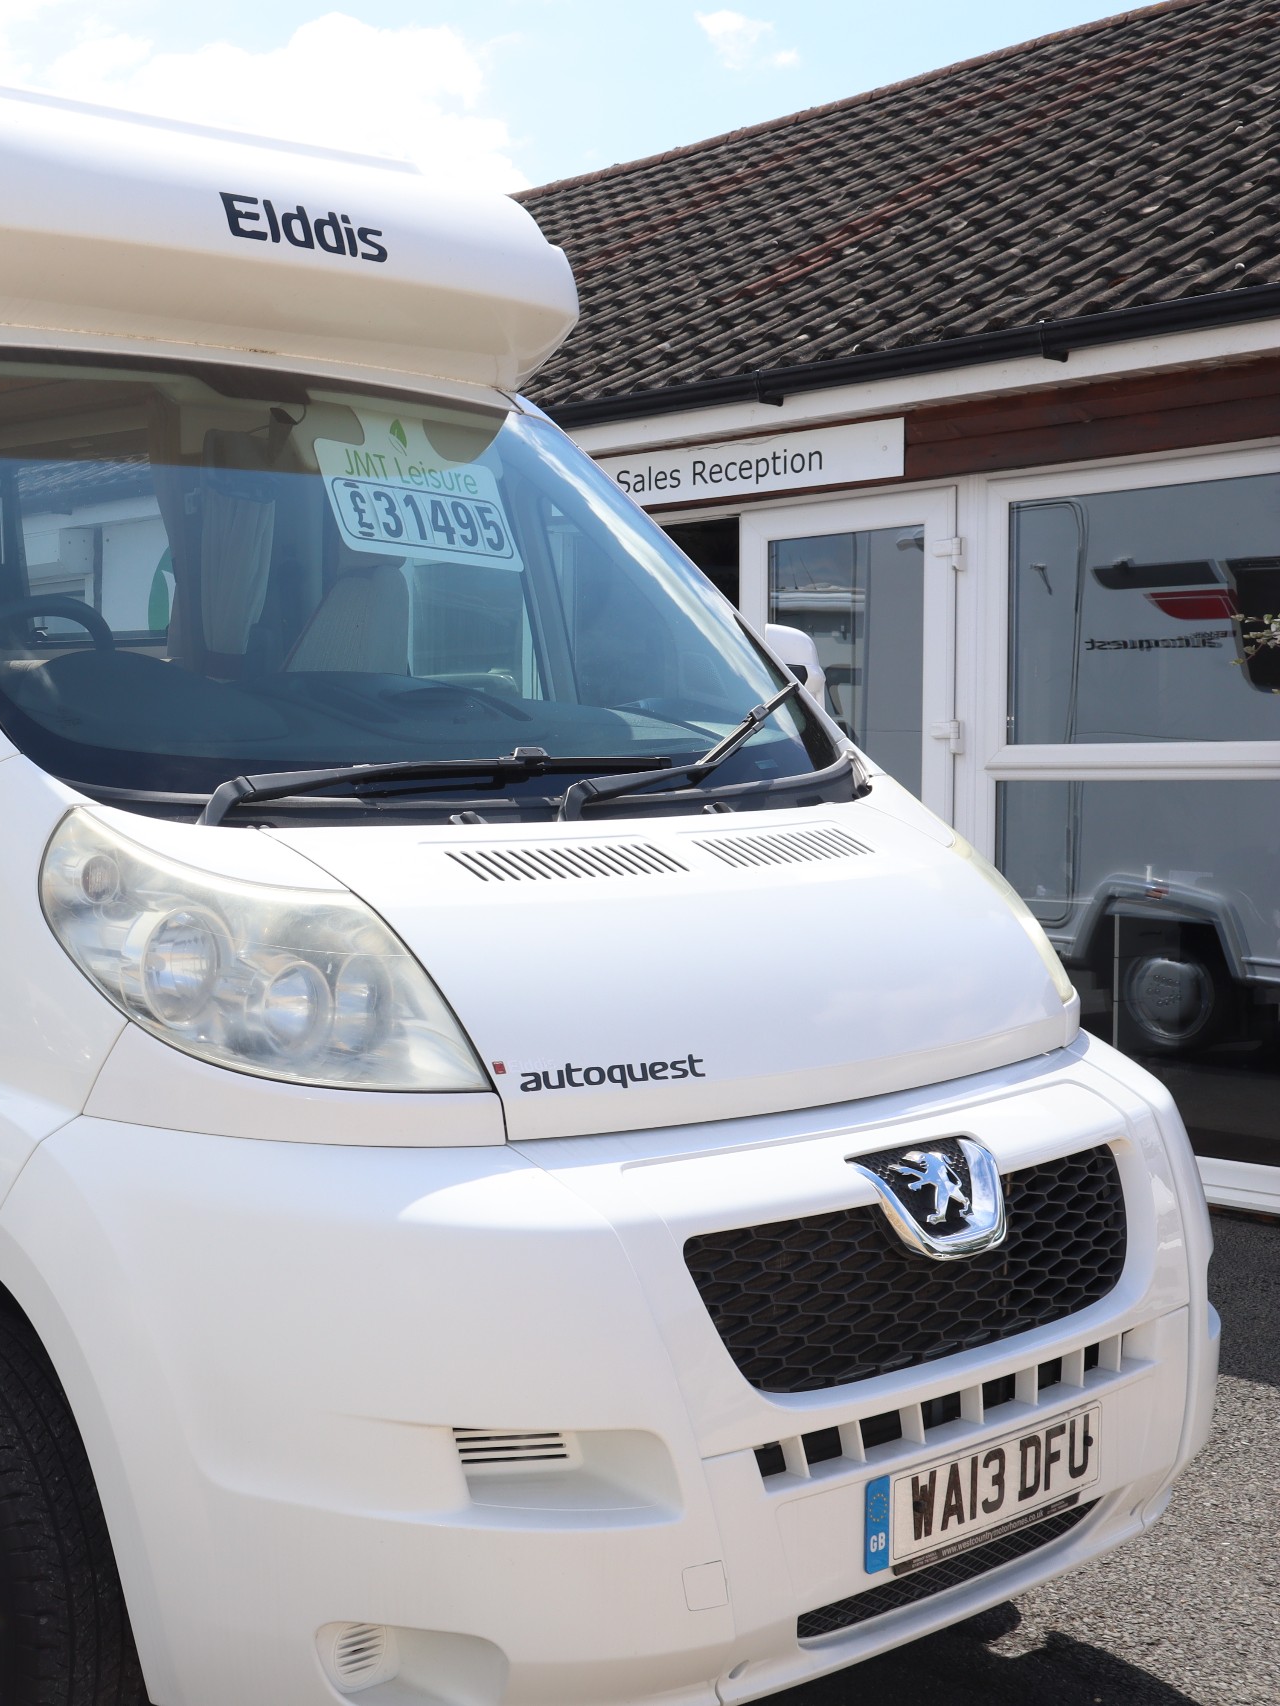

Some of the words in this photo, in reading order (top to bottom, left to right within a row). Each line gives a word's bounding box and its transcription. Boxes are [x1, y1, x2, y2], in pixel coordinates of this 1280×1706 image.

[218, 191, 388, 263] Elddis
[344, 448, 389, 481] JMT
[393, 456, 479, 495] Leisure
[616, 466, 681, 494] Sales
[692, 449, 823, 486] Reception
[347, 488, 505, 552] £31495
[520, 1053, 706, 1093] autoquest
[911, 1447, 1006, 1541] WA13
[1018, 1413, 1091, 1503] DFU
[870, 1531, 886, 1553] GB
